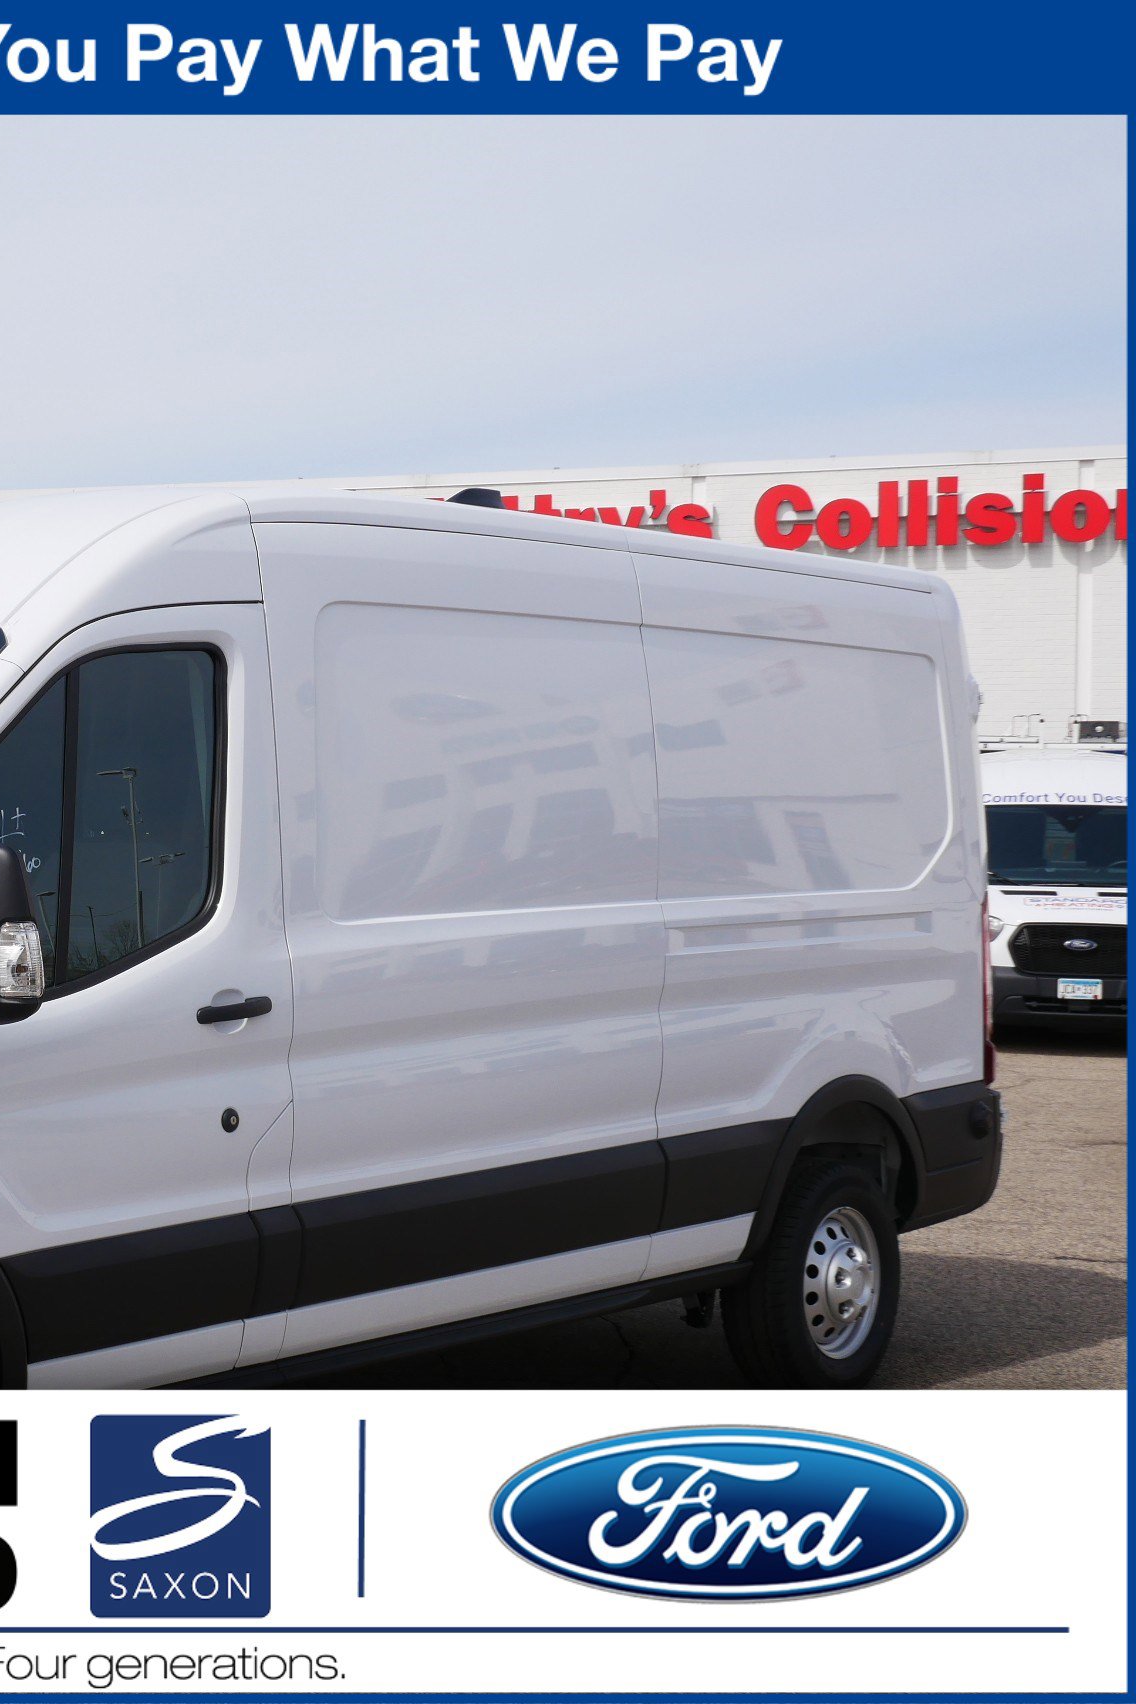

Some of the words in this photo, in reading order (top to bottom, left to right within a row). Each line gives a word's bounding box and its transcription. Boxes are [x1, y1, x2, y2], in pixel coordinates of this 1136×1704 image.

[755, 473, 1127, 550] Collisio
[982, 792, 1048, 804] Comfort
[1055, 793, 1086, 803] You
